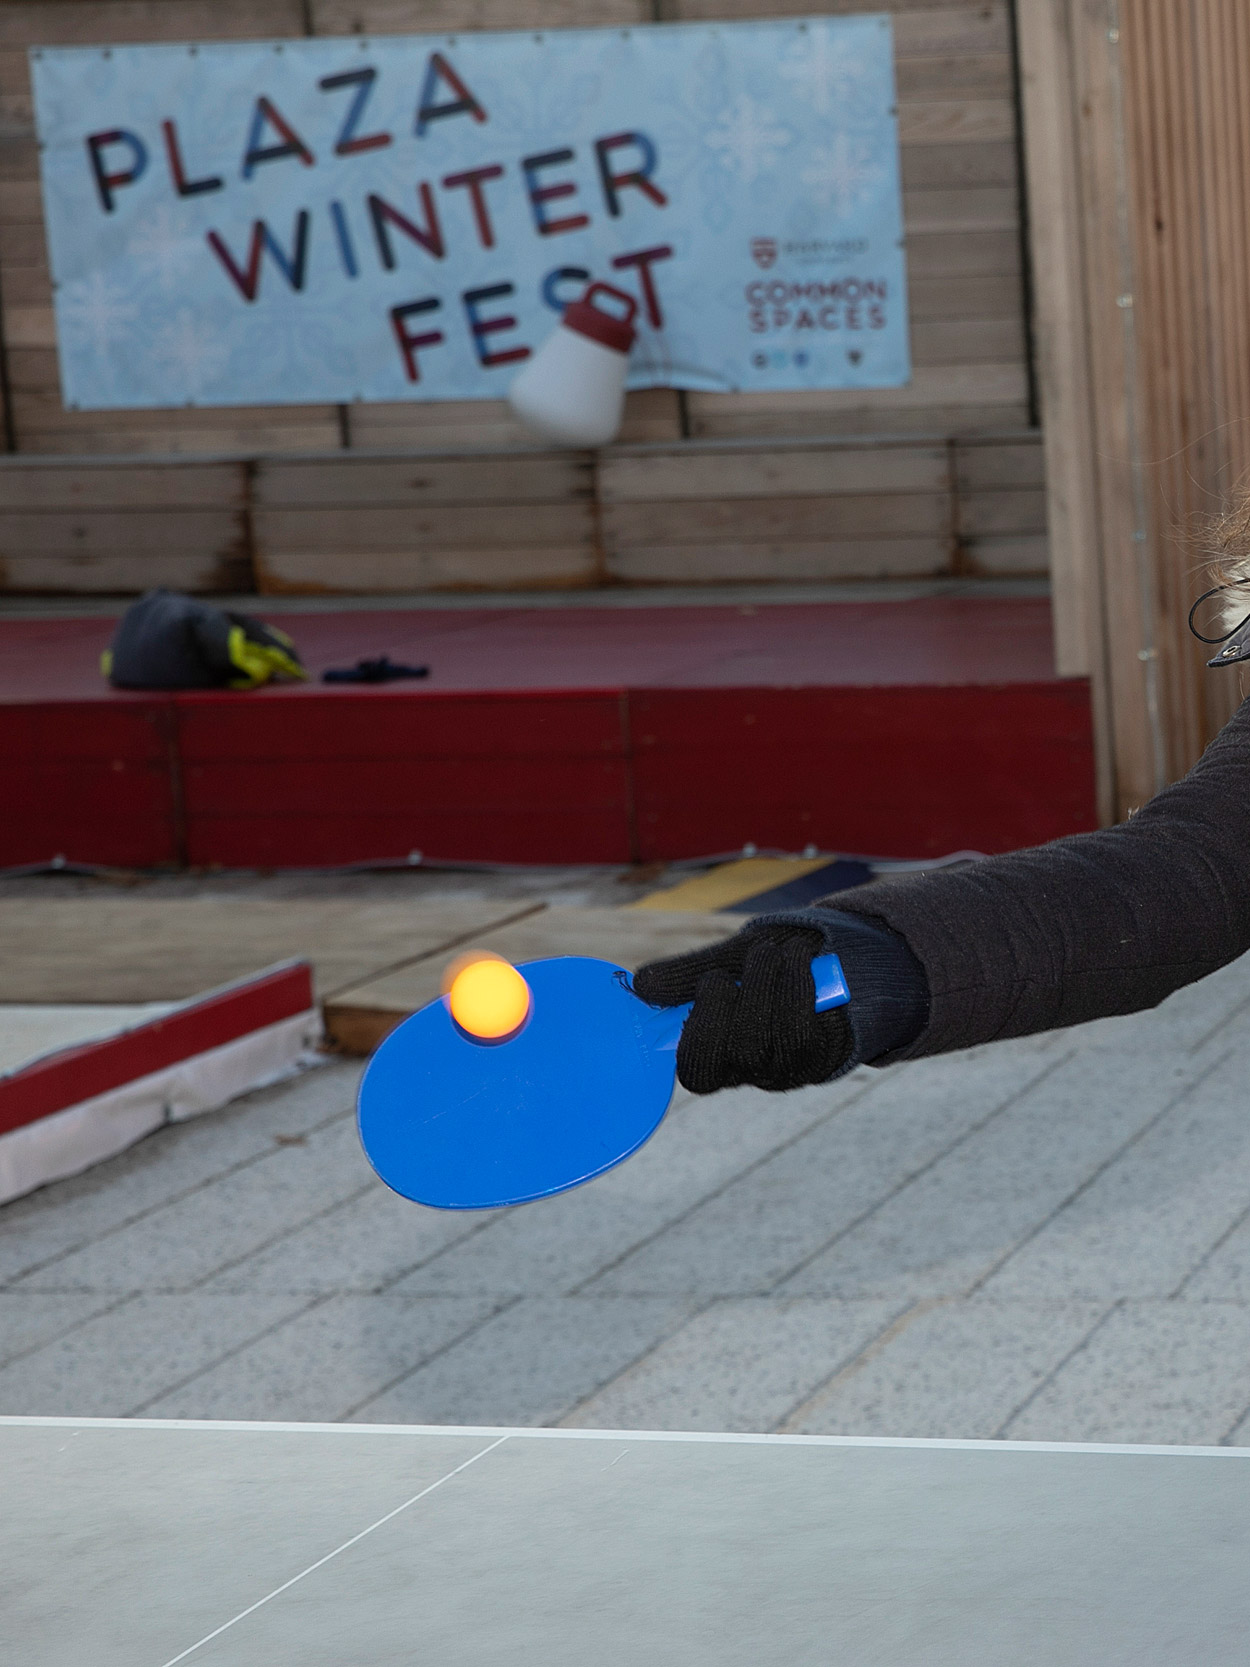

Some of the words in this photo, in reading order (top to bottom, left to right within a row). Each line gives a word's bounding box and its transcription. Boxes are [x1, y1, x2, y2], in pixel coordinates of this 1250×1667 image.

[87, 52, 488, 214] PLAZA
[206, 130, 668, 305] WINTER
[746, 276, 887, 305] COMMON
[750, 304, 887, 333] SPACES
